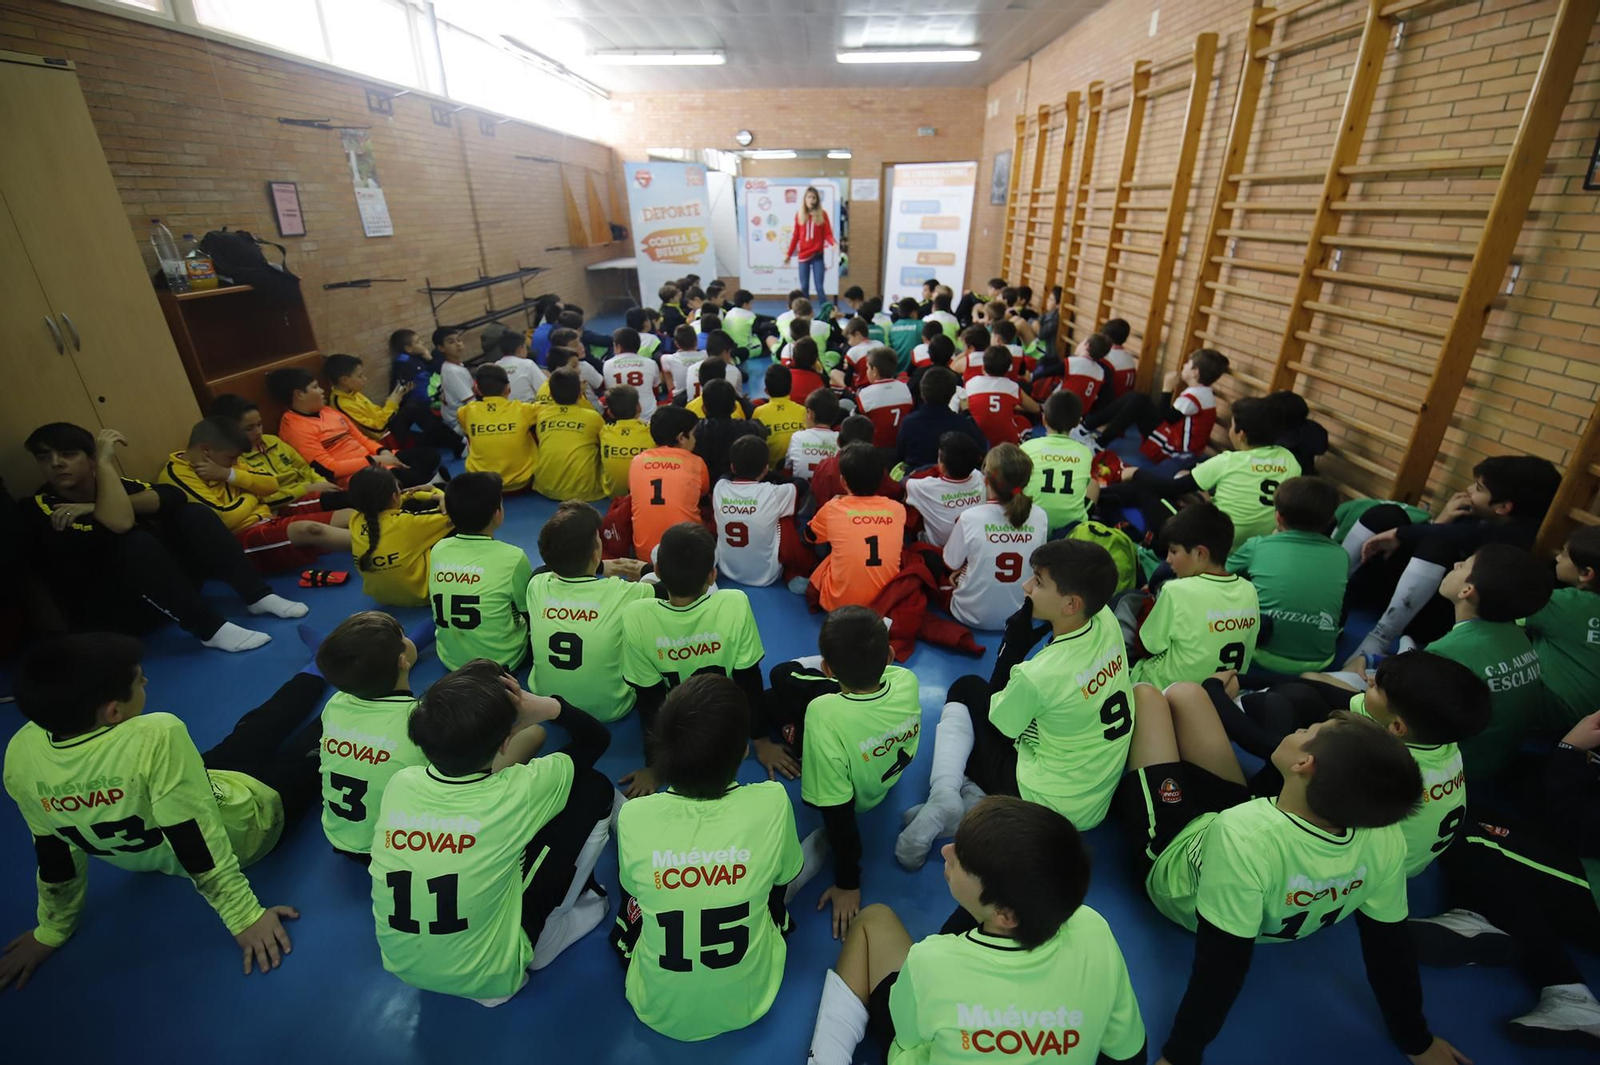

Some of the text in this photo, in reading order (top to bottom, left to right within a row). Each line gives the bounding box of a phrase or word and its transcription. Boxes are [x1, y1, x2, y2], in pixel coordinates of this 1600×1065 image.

[642, 203, 701, 222] DEPORTE
[613, 371, 644, 386] 18
[1084, 381, 1095, 397] 8
[1125, 372, 1134, 387] 11
[989, 395, 1001, 413] 5
[477, 423, 517, 433] ECCF
[548, 420, 587, 431] ECCF
[890, 408, 900, 427] 7
[644, 462, 681, 471] COVAP
[1044, 454, 1081, 464] COVAP
[650, 478, 666, 505] 1
[1041, 468, 1074, 495] 11
[722, 505, 757, 515] COVAP
[947, 495, 982, 508] COVAP
[852, 516, 893, 525] COVAP
[725, 521, 749, 547] 9
[989, 533, 1033, 543] COVAP
[865, 535, 882, 567] 1
[436, 571, 481, 585] COVAP
[995, 552, 1023, 583] 9
[432, 593, 482, 630] 15
[546, 607, 599, 622] COVAP
[1214, 617, 1256, 633] COVAP
[549, 632, 583, 670] 9
[667, 641, 722, 661] COVAP
[1215, 641, 1246, 675] 9
[1087, 654, 1123, 695] COVAP
[1100, 690, 1133, 741] 9
[327, 738, 391, 765] COVAP
[328, 772, 369, 822] 3
[1430, 770, 1466, 801] COVA
[51, 788, 125, 813] COVAP
[55, 814, 164, 856] 13
[391, 829, 476, 854] COVAP
[652, 845, 751, 868] Muévete
[662, 863, 747, 889] COVAP
[386, 870, 469, 935] 11
[656, 901, 750, 972] 15
[957, 1003, 1083, 1028] Muévete
[972, 1029, 1080, 1056] COVAP
